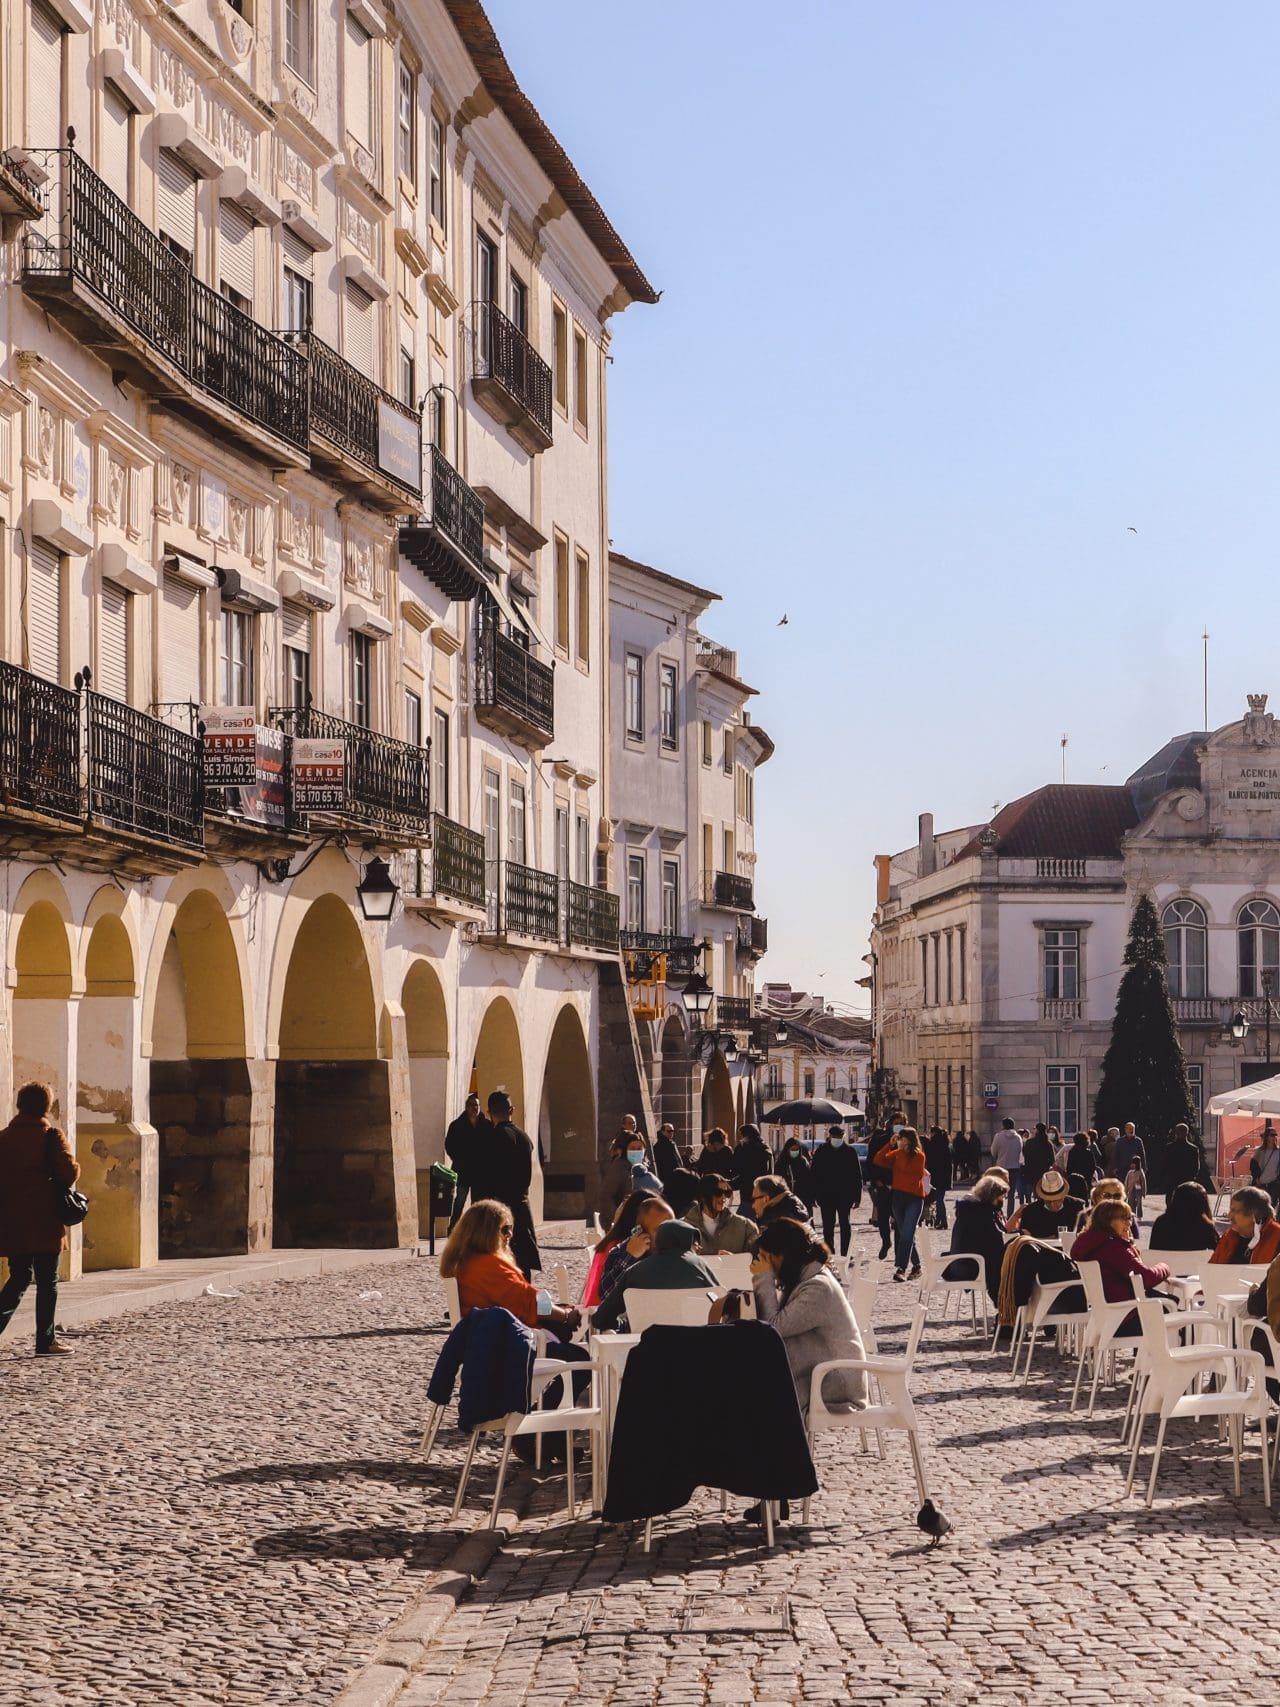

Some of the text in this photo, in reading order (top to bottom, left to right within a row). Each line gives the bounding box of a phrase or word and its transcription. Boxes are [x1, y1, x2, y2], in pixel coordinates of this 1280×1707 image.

[223, 718, 254, 728] casa10
[203, 738, 255, 748] VENDE
[256, 725, 282, 751] ENDE-SE
[223, 754, 255, 763] Simões
[314, 749, 343, 759] casa10
[203, 763, 214, 776] 96
[215, 763, 231, 776] 370
[233, 763, 243, 776] 40
[245, 763, 255, 776] 20
[295, 767, 343, 777] VENDE
[1253, 780, 1266, 788] DO
[295, 791, 306, 802] 96
[307, 791, 320, 802] 170
[322, 791, 332, 802] 65
[333, 791, 343, 802] 78
[1228, 790, 1248, 800] BANCO
[1249, 790, 1257, 800] DE
